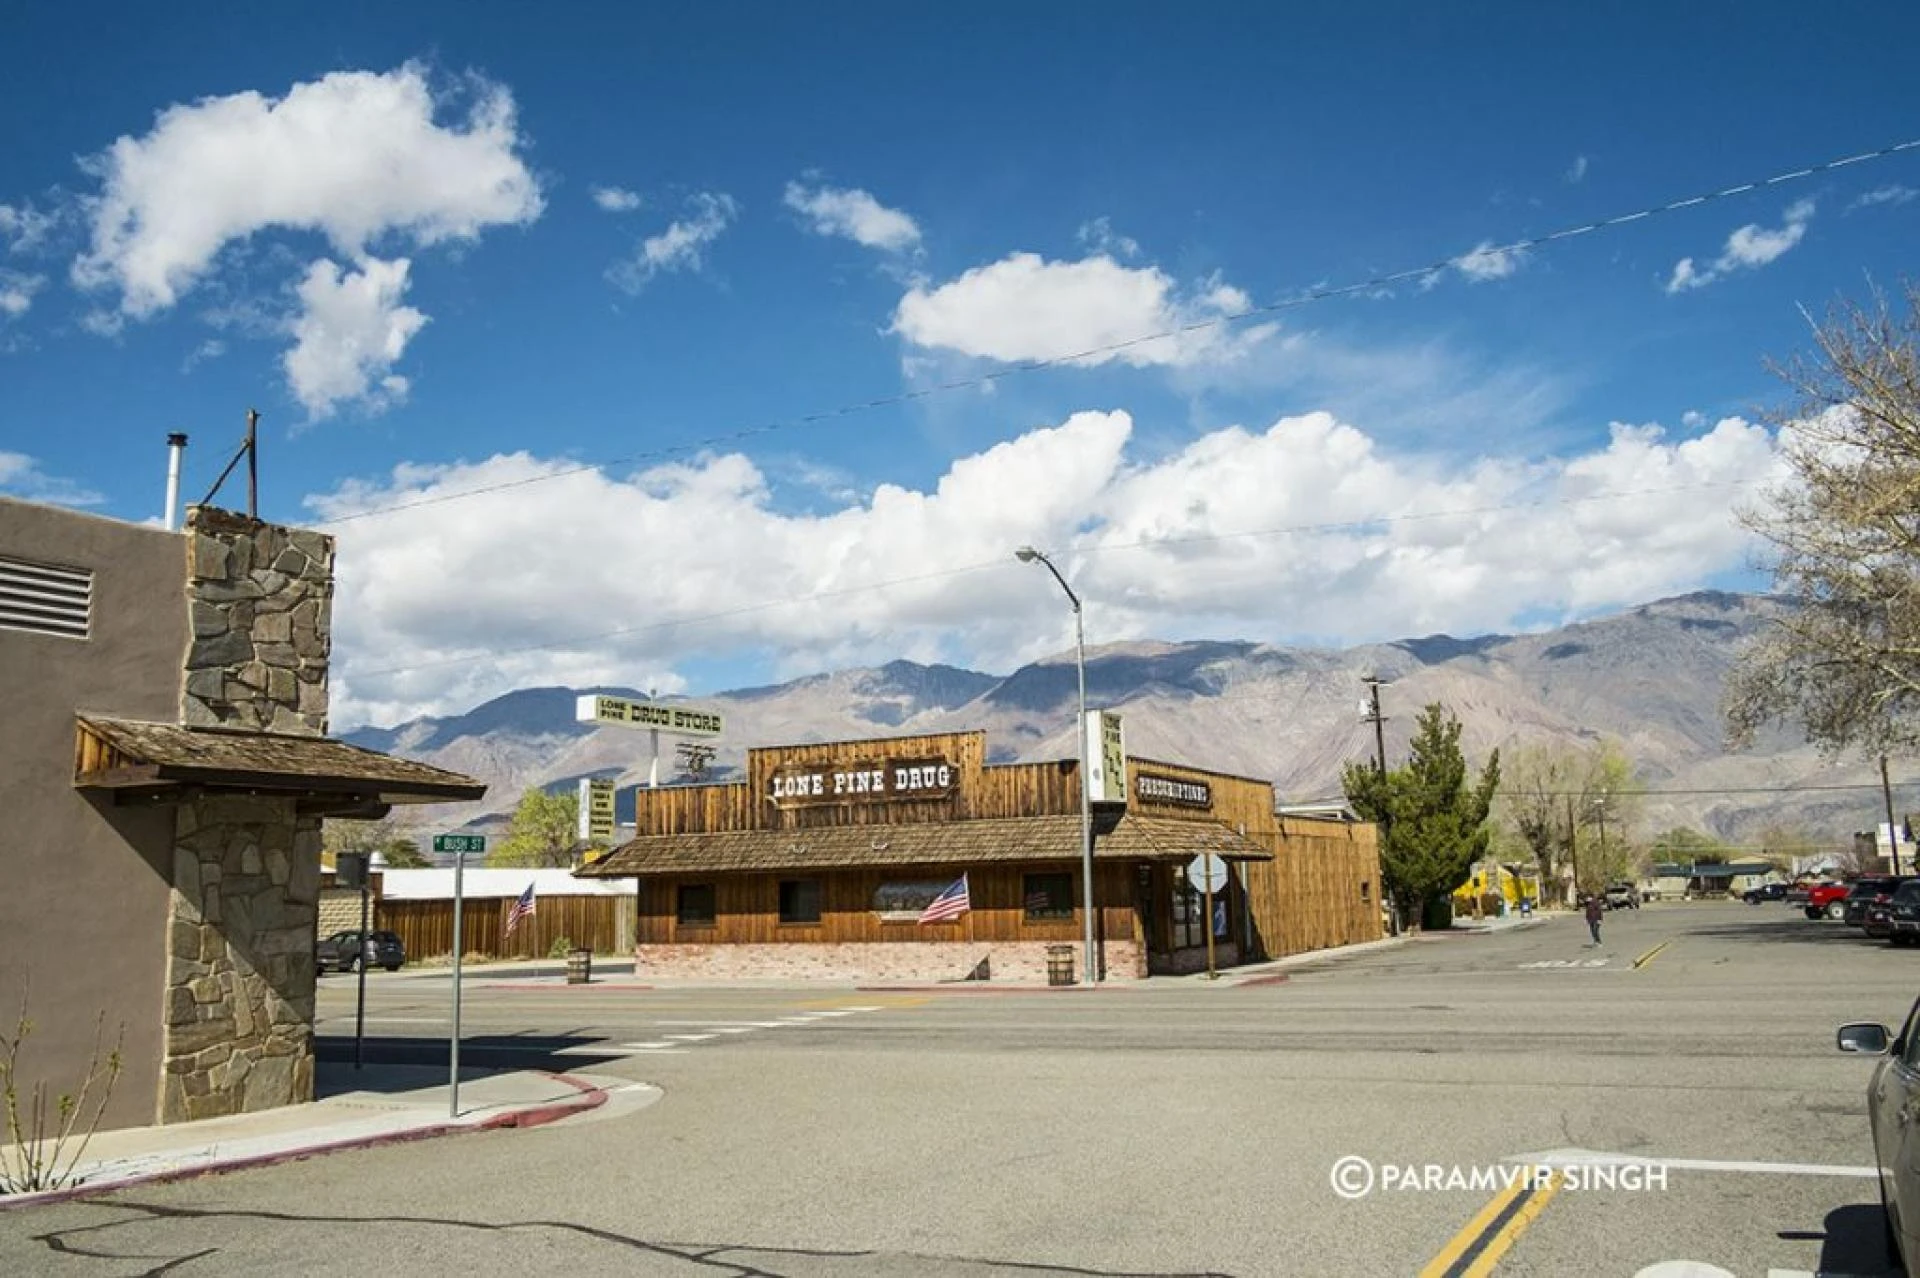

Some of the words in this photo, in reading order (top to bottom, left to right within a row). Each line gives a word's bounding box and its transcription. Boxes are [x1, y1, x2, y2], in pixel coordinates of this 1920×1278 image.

[631, 704, 670, 726] DRUG
[674, 710, 721, 732] STORE
[773, 773, 824, 798] LONE
[833, 769, 885, 794] PINE
[894, 765, 951, 790] DRUG
[443, 836, 468, 850] BUSH
